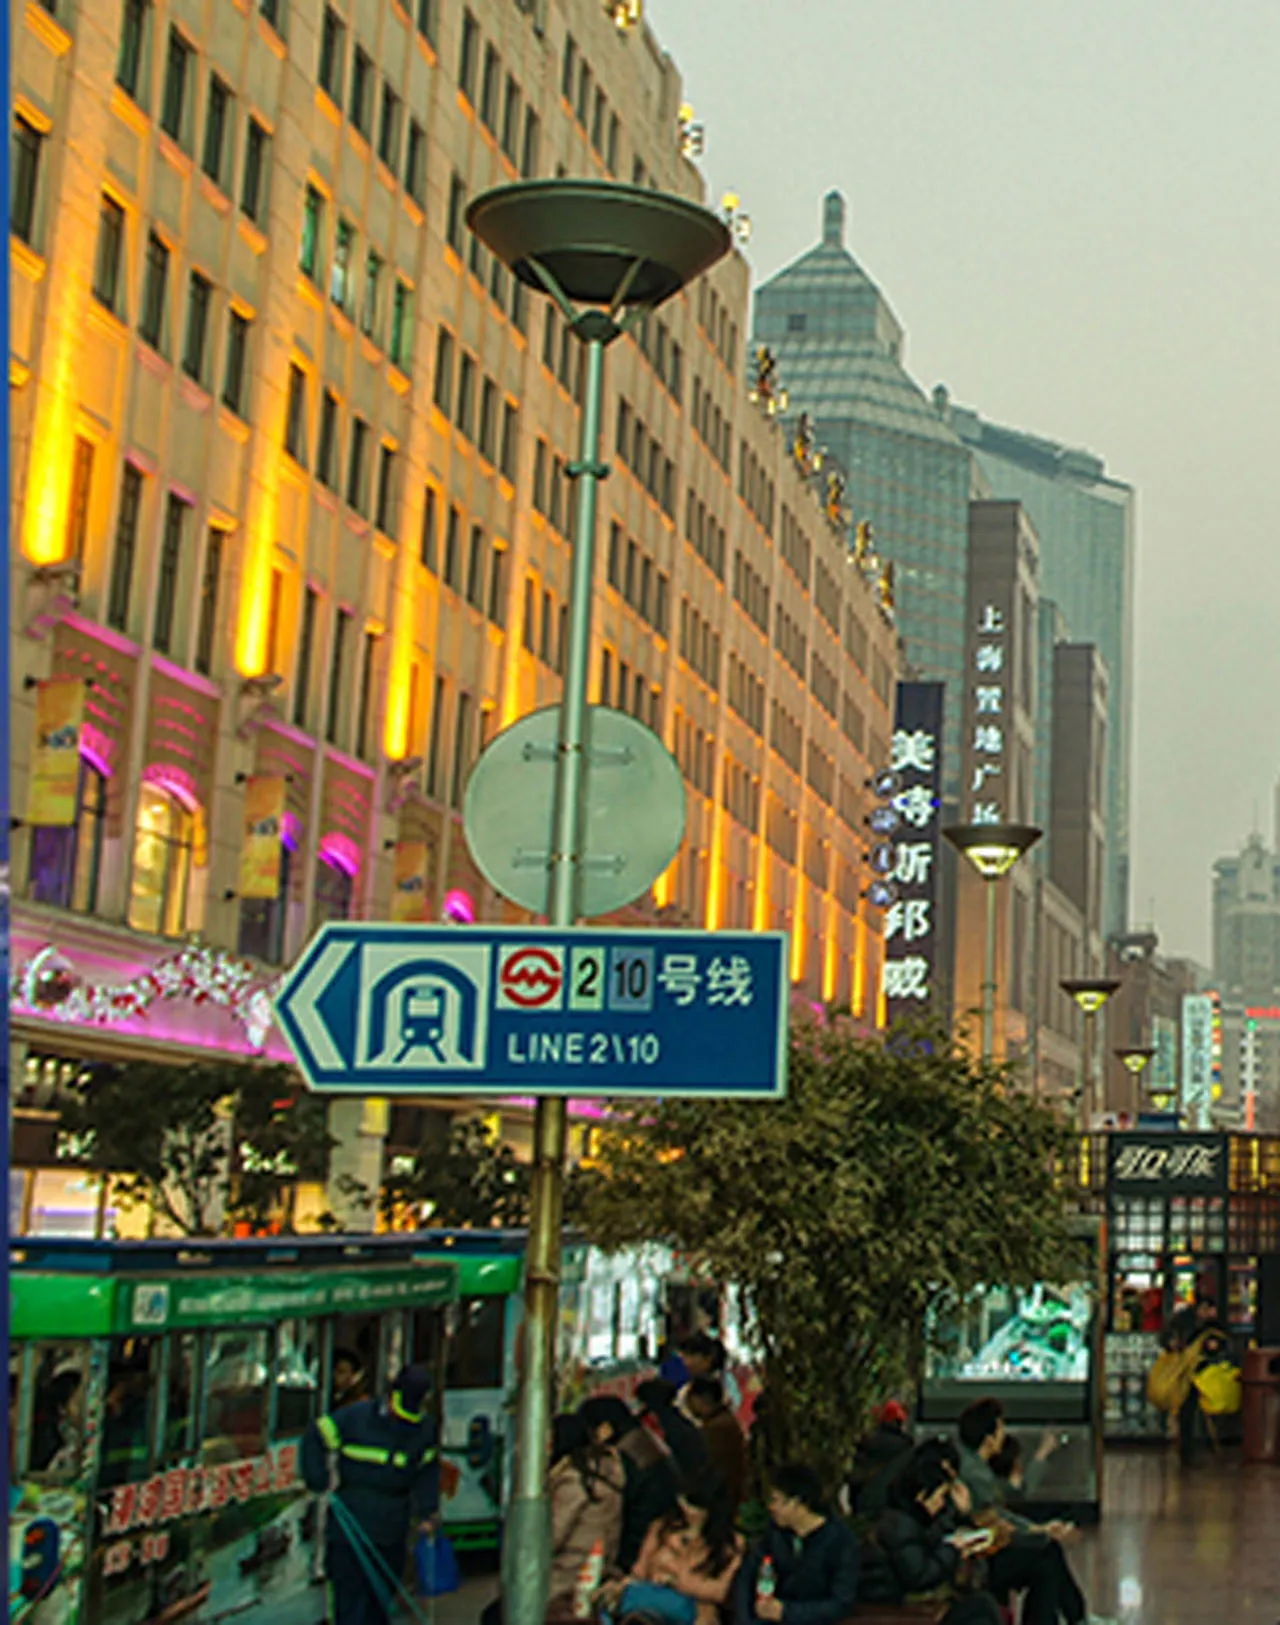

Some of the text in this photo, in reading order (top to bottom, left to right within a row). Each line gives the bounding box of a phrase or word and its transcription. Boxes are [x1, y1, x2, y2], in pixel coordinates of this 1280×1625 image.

[880, 729, 938, 1001] 美特斯邦威
[577, 953, 754, 1007] 2 10 号线
